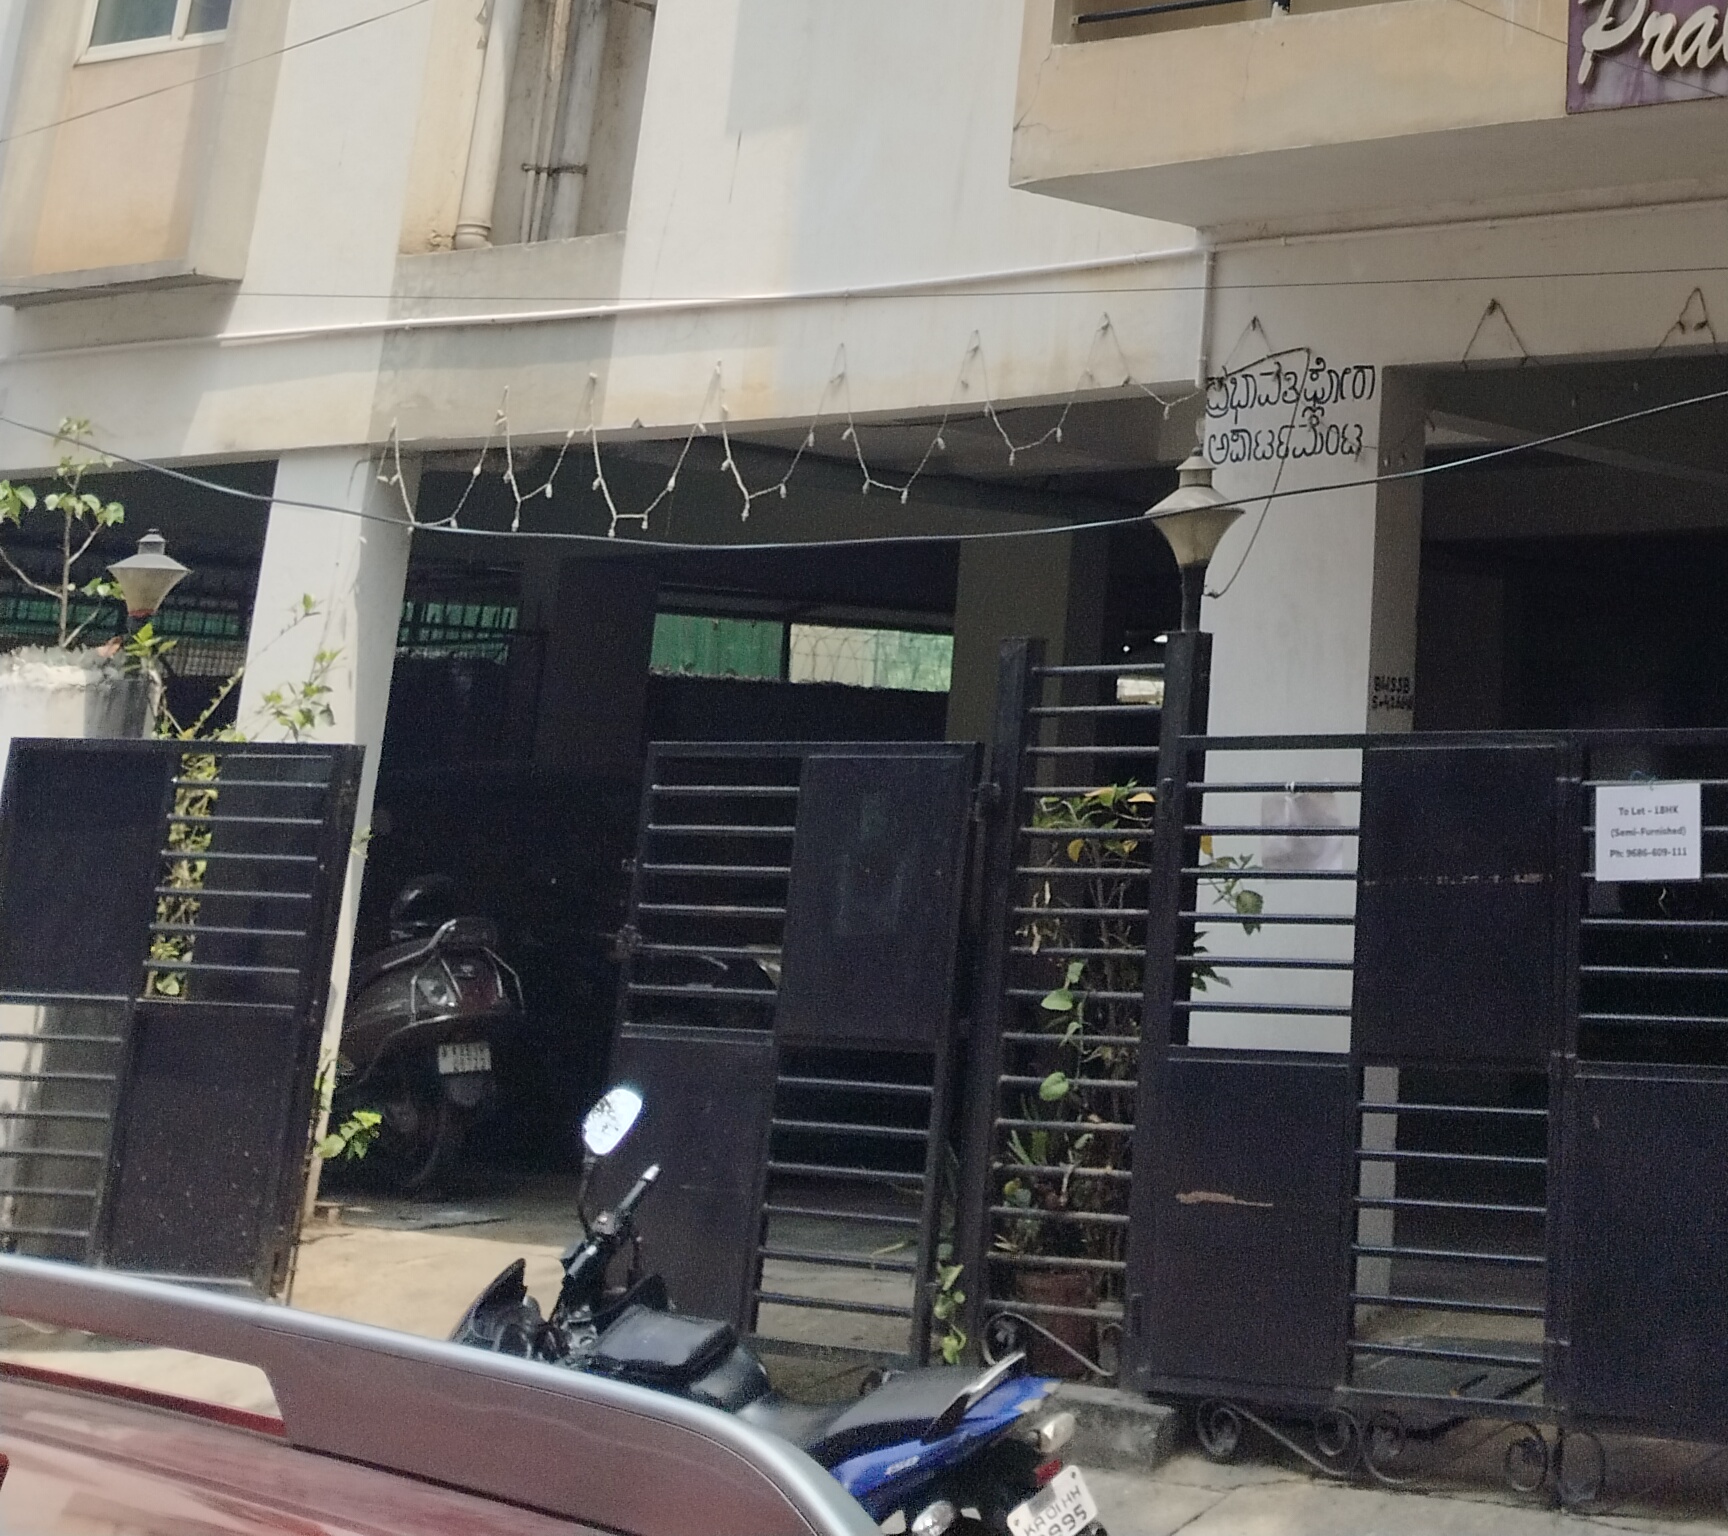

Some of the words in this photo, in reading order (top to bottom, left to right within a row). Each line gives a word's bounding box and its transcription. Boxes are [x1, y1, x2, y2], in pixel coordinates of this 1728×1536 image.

[1618, 806, 1629, 816] To
[1631, 806, 1645, 816] Let
[1655, 805, 1679, 815] 1BHK
[1610, 826, 1687, 838] (Semi-Furnished)
